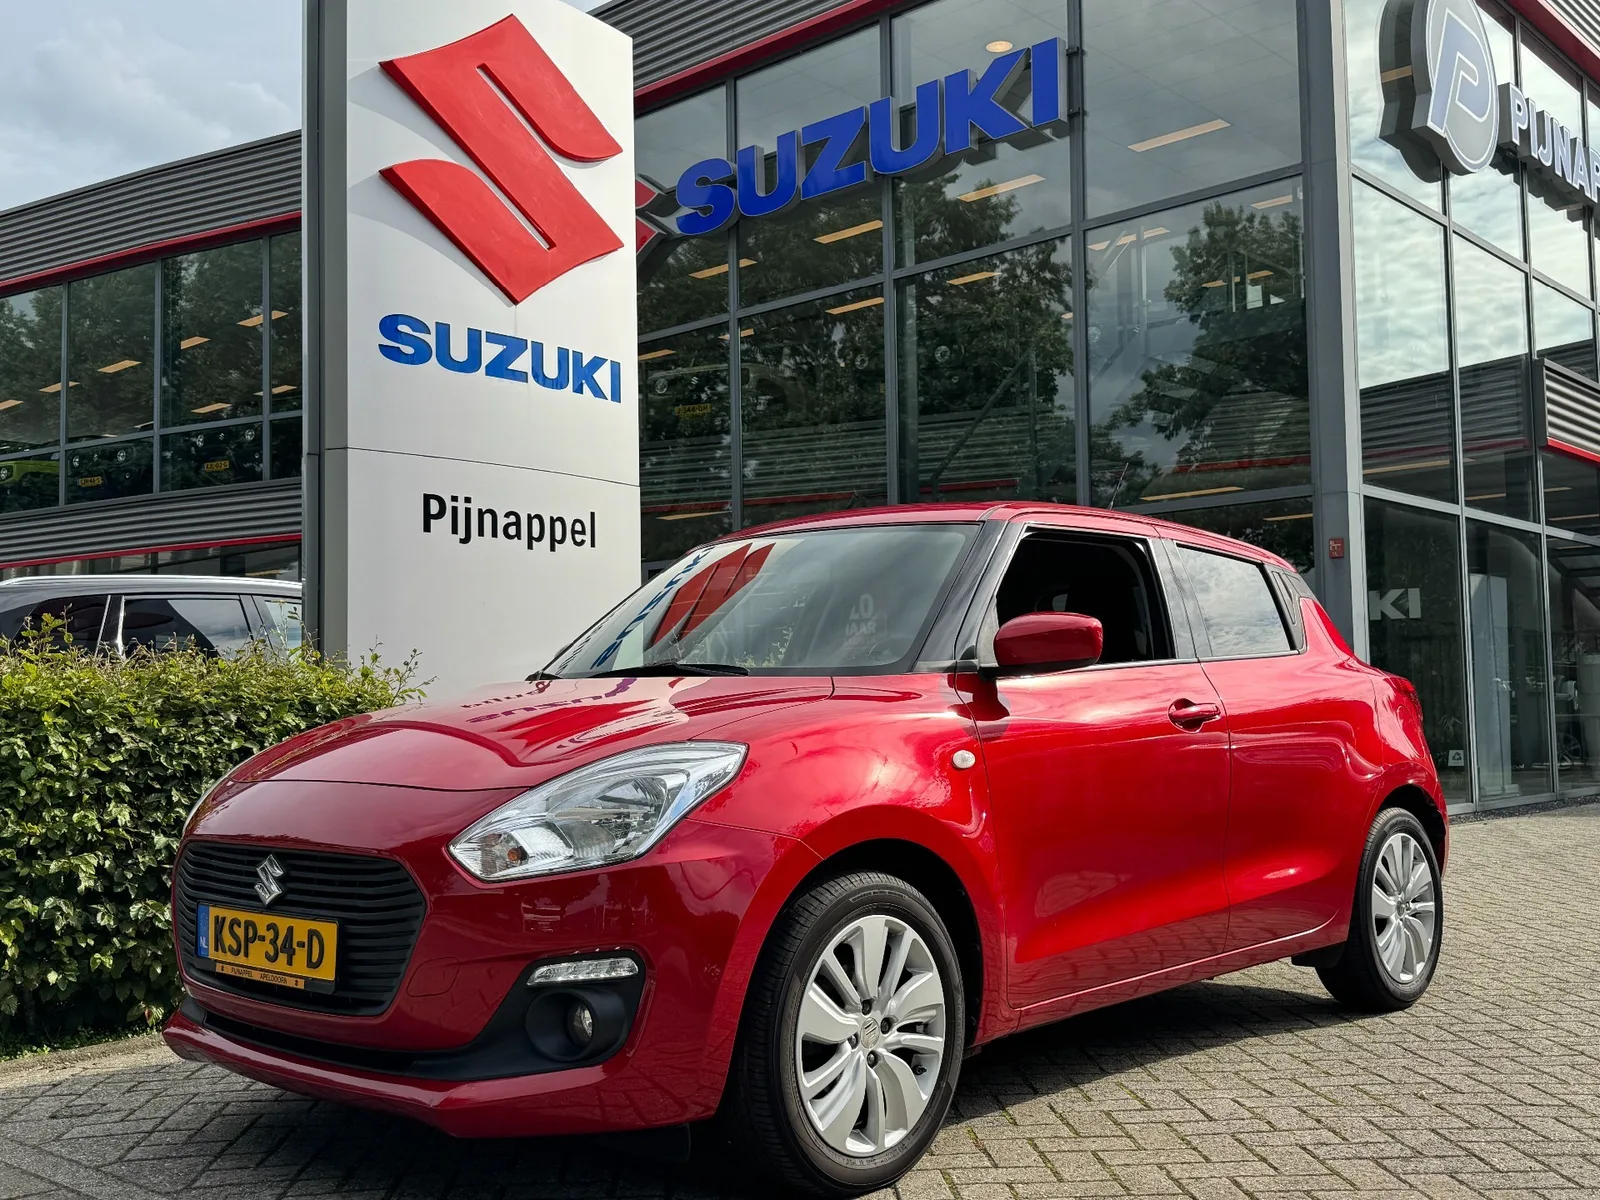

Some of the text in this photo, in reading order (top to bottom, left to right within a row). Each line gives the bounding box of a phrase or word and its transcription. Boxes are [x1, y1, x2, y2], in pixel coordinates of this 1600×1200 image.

[675, 37, 1063, 236] SUZUKI
[378, 313, 622, 404] SUZUKI
[422, 493, 597, 552] Pijnappel
[213, 914, 325, 970] KSP-34-D
